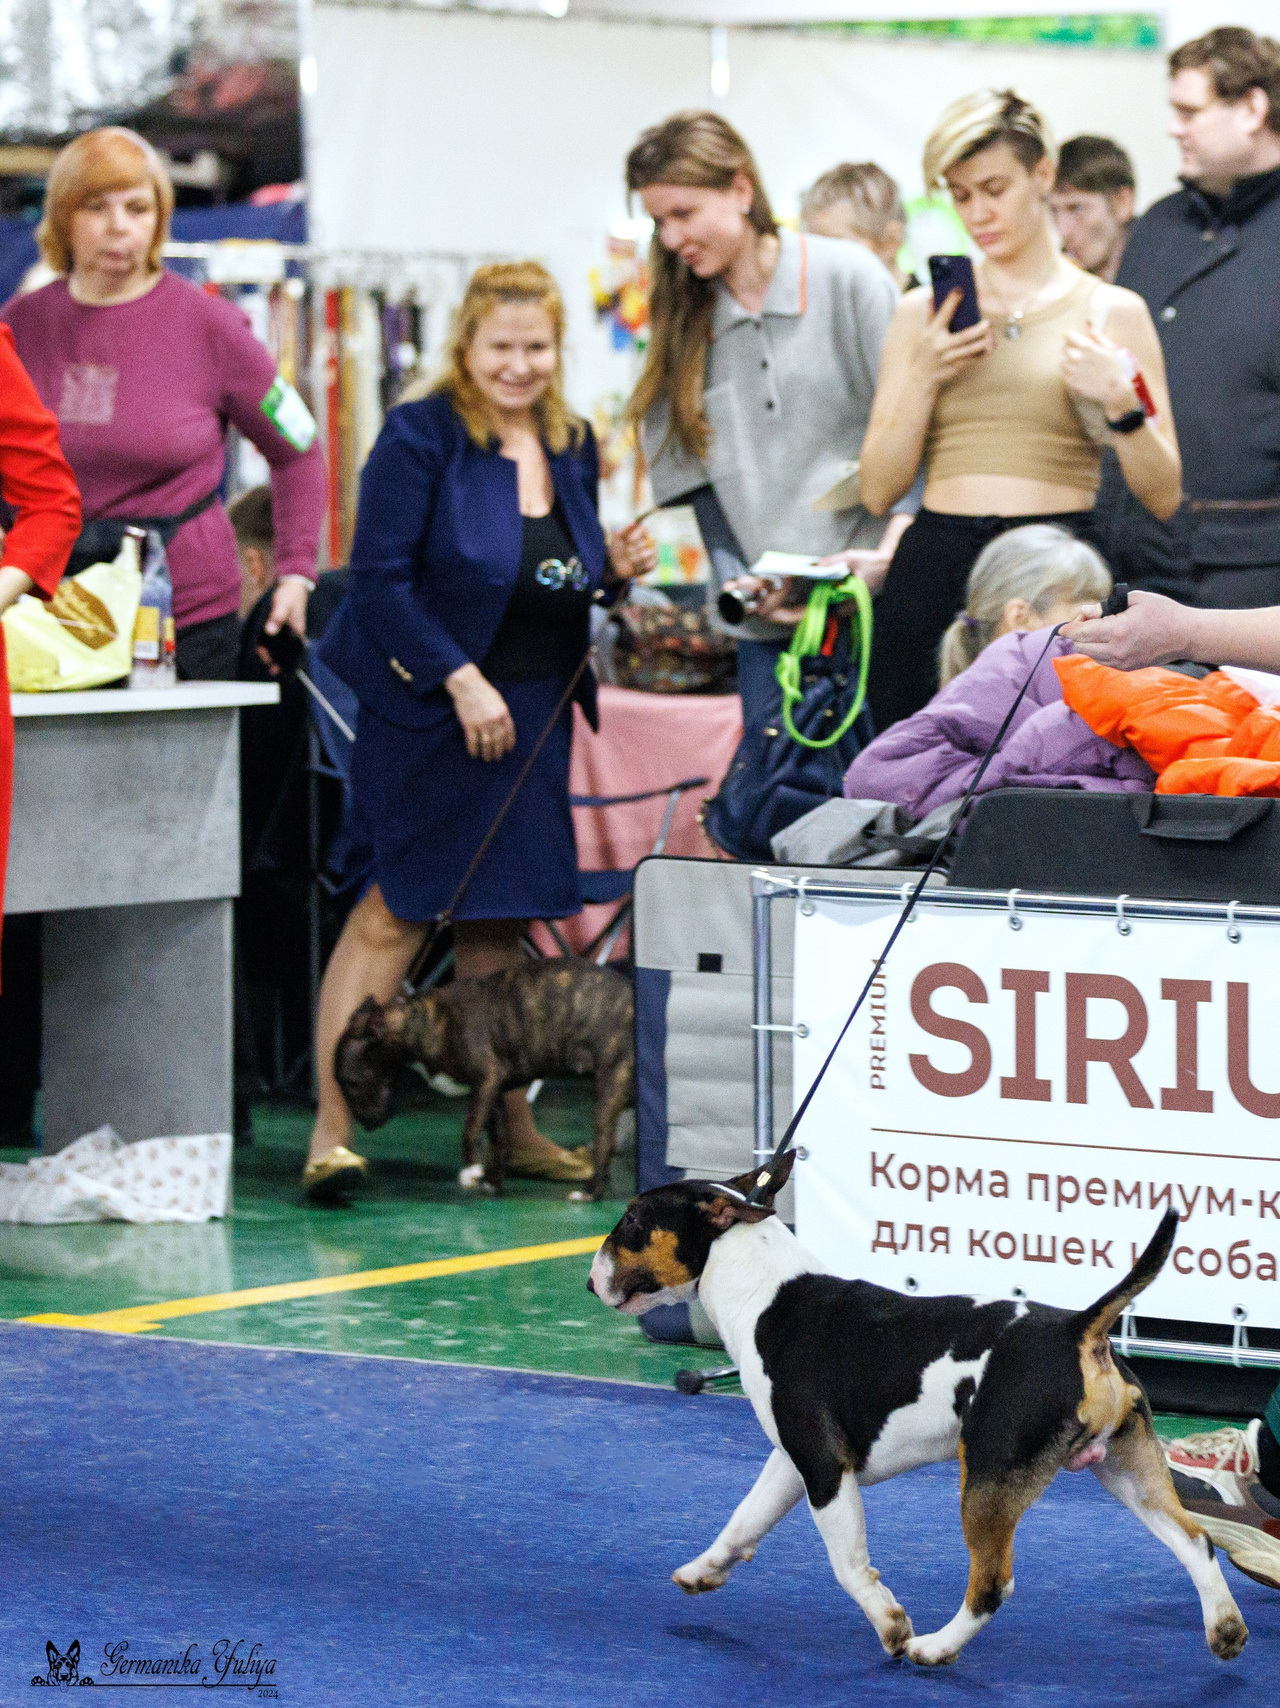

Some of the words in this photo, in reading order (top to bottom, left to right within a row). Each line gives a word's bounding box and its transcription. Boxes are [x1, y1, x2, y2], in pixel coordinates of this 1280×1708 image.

[870, 1152, 1009, 1201] Корма
[871, 1220, 950, 1256] для
[969, 1230, 1113, 1270] кошек
